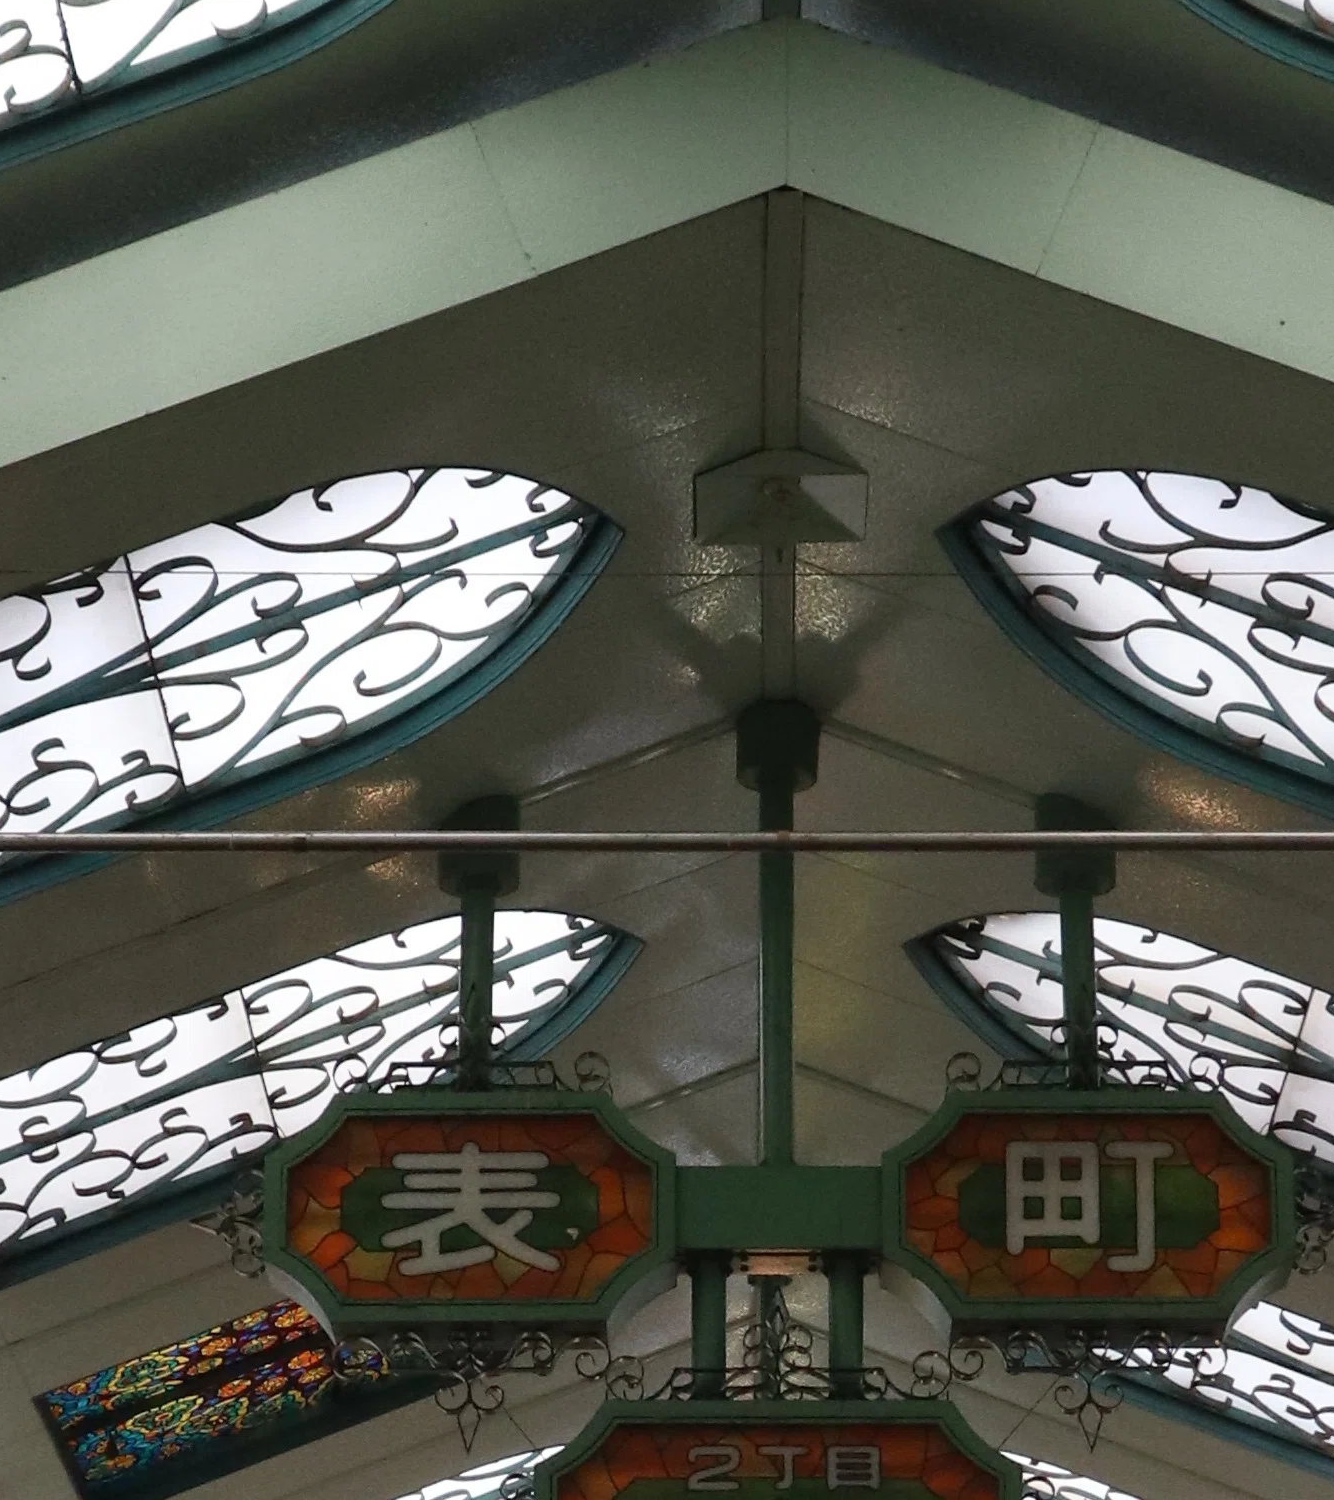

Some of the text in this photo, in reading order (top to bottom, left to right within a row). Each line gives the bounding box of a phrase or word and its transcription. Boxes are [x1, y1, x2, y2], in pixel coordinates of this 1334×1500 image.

[380, 1140, 561, 1279] 表
[1005, 1139, 1173, 1272] 町
[687, 1445, 881, 1492] 2丁目
